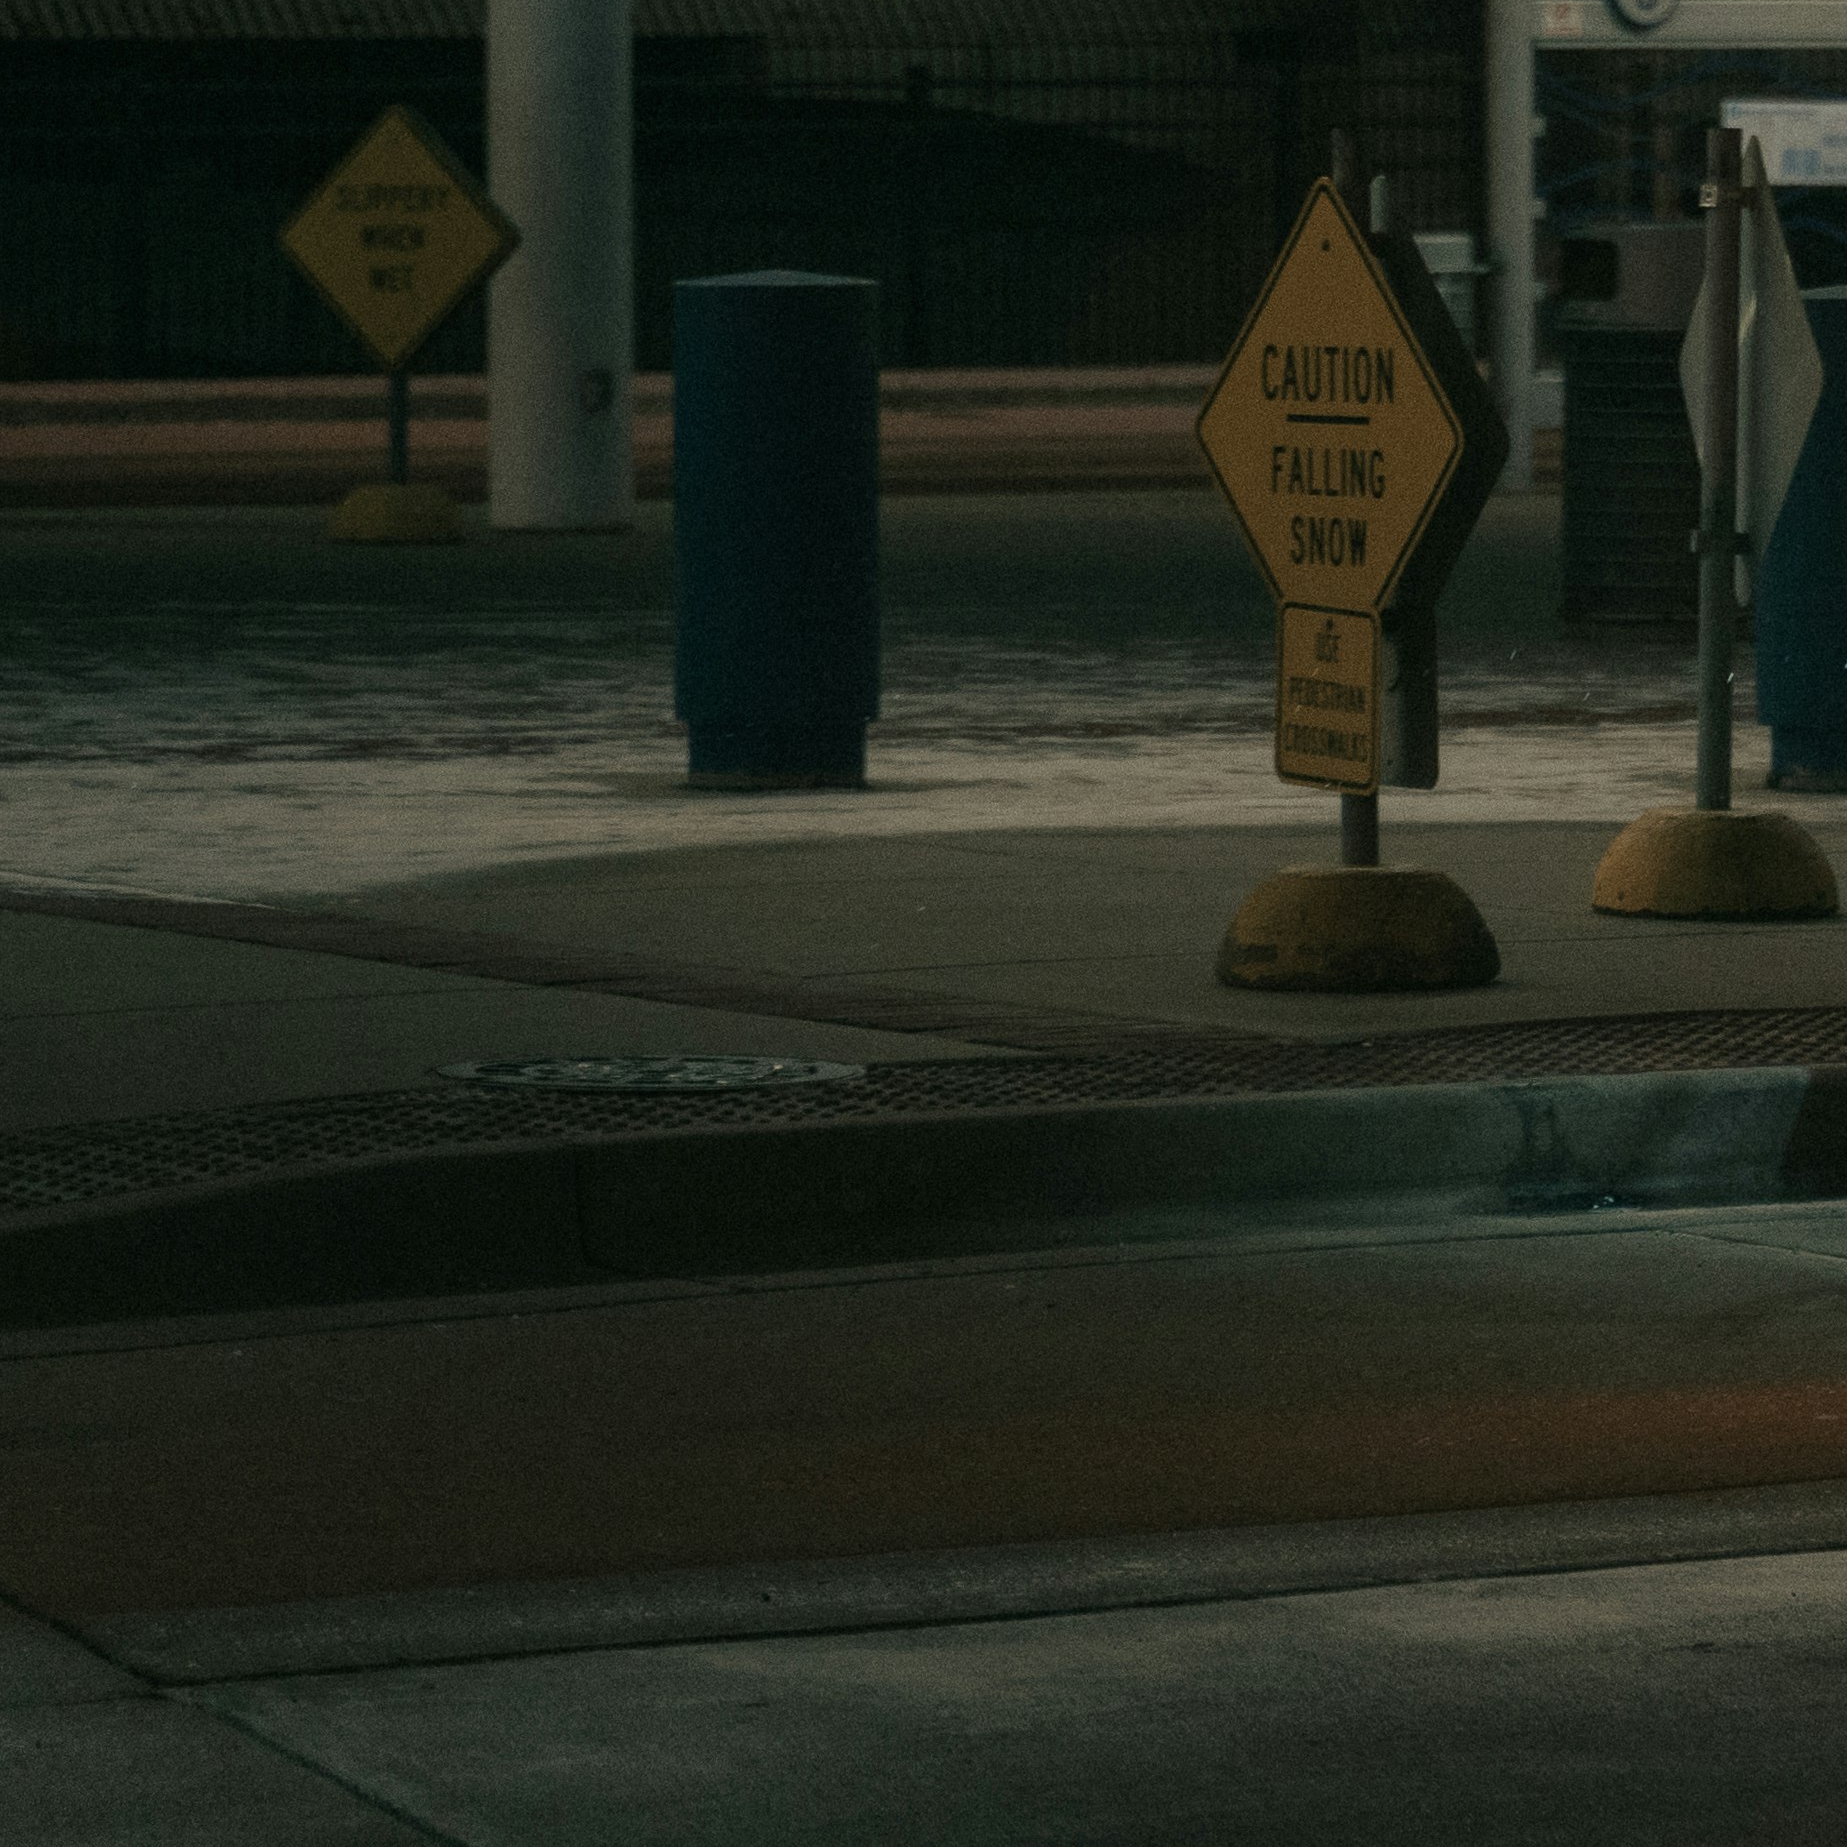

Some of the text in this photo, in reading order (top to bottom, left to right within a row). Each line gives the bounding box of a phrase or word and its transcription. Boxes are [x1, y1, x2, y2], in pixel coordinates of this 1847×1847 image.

[1261, 344, 1394, 406] CAUTION
[1271, 445, 1386, 500] FALLING
[1289, 515, 1367, 568] SNOW
[1288, 676, 1366, 714] PEDESTRIAN
[1284, 722, 1368, 763] CROSSWALKS
